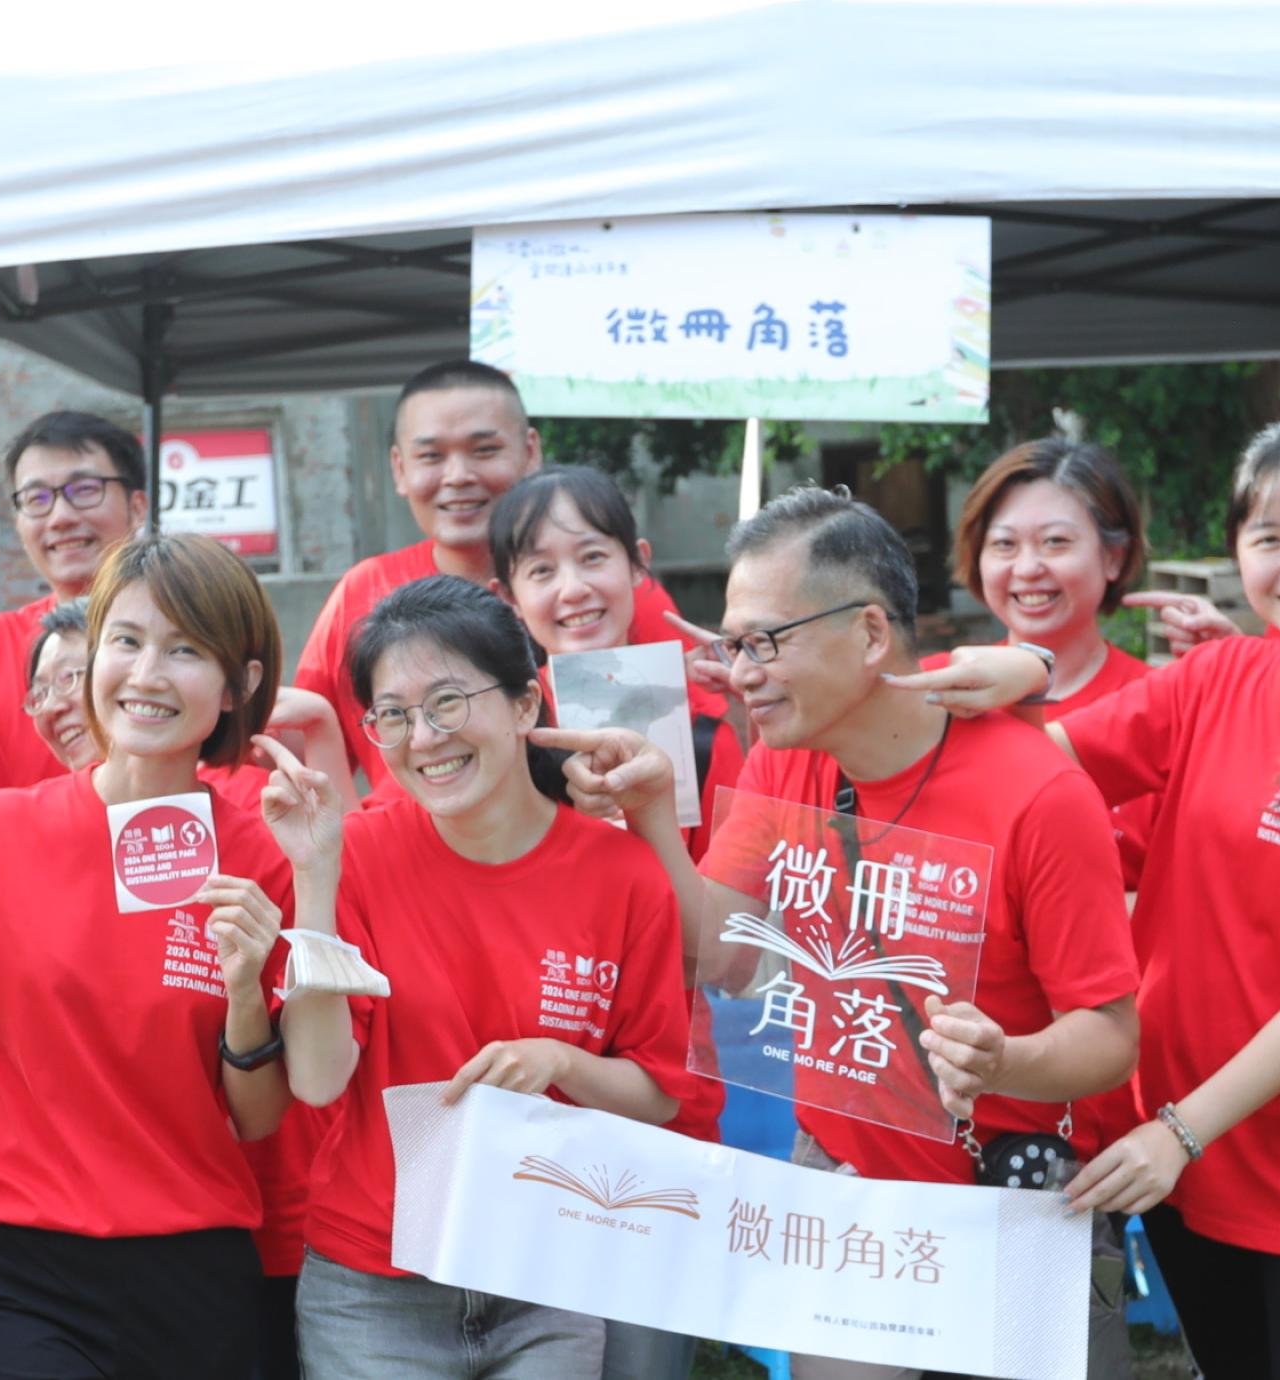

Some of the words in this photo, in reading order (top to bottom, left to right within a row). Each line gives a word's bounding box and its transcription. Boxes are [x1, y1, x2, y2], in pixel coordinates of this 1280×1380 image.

[606, 300, 848, 357] 微冊角落
[124, 856, 141, 866] 2024
[141, 853, 157, 863] ONE
[157, 850, 178, 861] MORE
[178, 847, 198, 858] PAGE
[124, 863, 156, 875] READING
[156, 861, 172, 872] AND
[125, 870, 180, 887] SUSTAINABILITY
[180, 866, 209, 879] MARKET
[766, 840, 914, 940] 微冊
[918, 909, 938, 923] AND
[923, 896, 949, 911] MORE
[949, 900, 974, 916] PAGE
[166, 944, 191, 959] 2024
[192, 949, 213, 964] ONE
[163, 959, 209, 978] READING
[210, 969, 225, 982] AN
[541, 984, 563, 998] 2024
[749, 971, 902, 1068] 角落
[762, 1045, 791, 1061] ONE
[838, 1065, 878, 1085] PAGE
[558, 1207, 582, 1220] ONE
[585, 1213, 617, 1229] MORE
[619, 1220, 652, 1236] PAGE
[726, 1197, 946, 1284] 微冊角落
